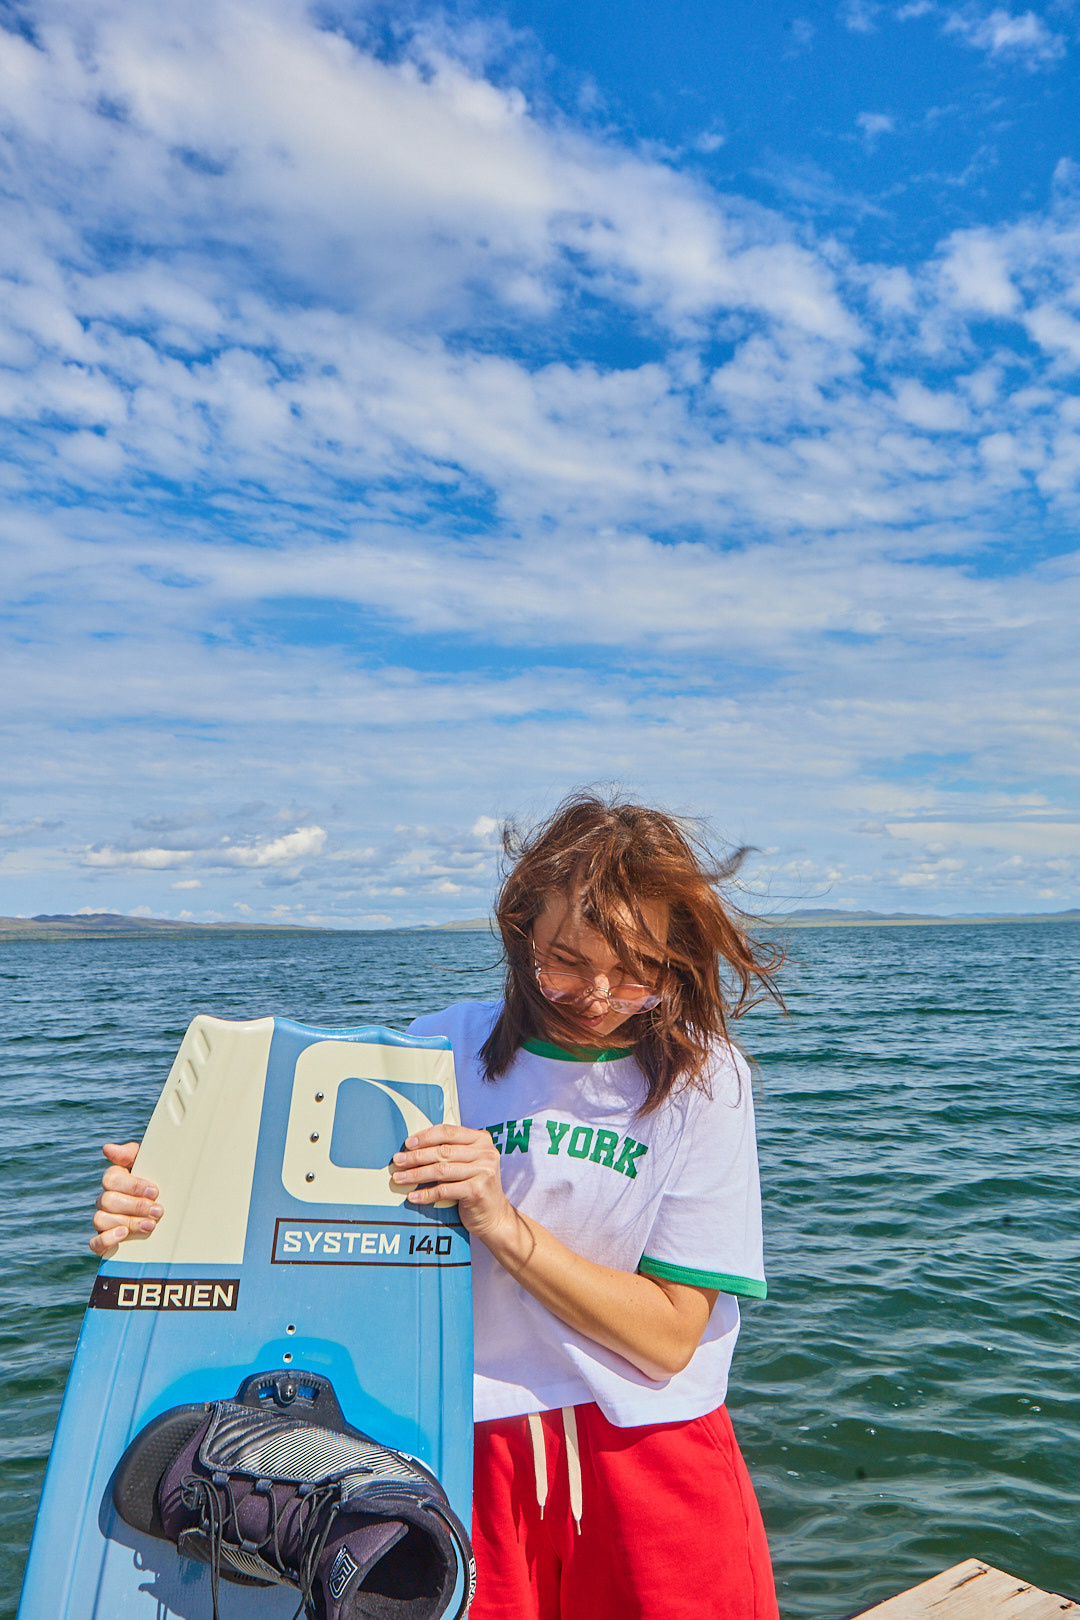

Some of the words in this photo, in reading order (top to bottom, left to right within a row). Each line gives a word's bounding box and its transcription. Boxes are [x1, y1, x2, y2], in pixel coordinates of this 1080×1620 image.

[479, 1118, 533, 1155] EW
[545, 1120, 649, 1180] YORK
[283, 1231, 401, 1255] SYSTEM
[408, 1235, 452, 1256] 140
[117, 1283, 234, 1307] OBRIEN
